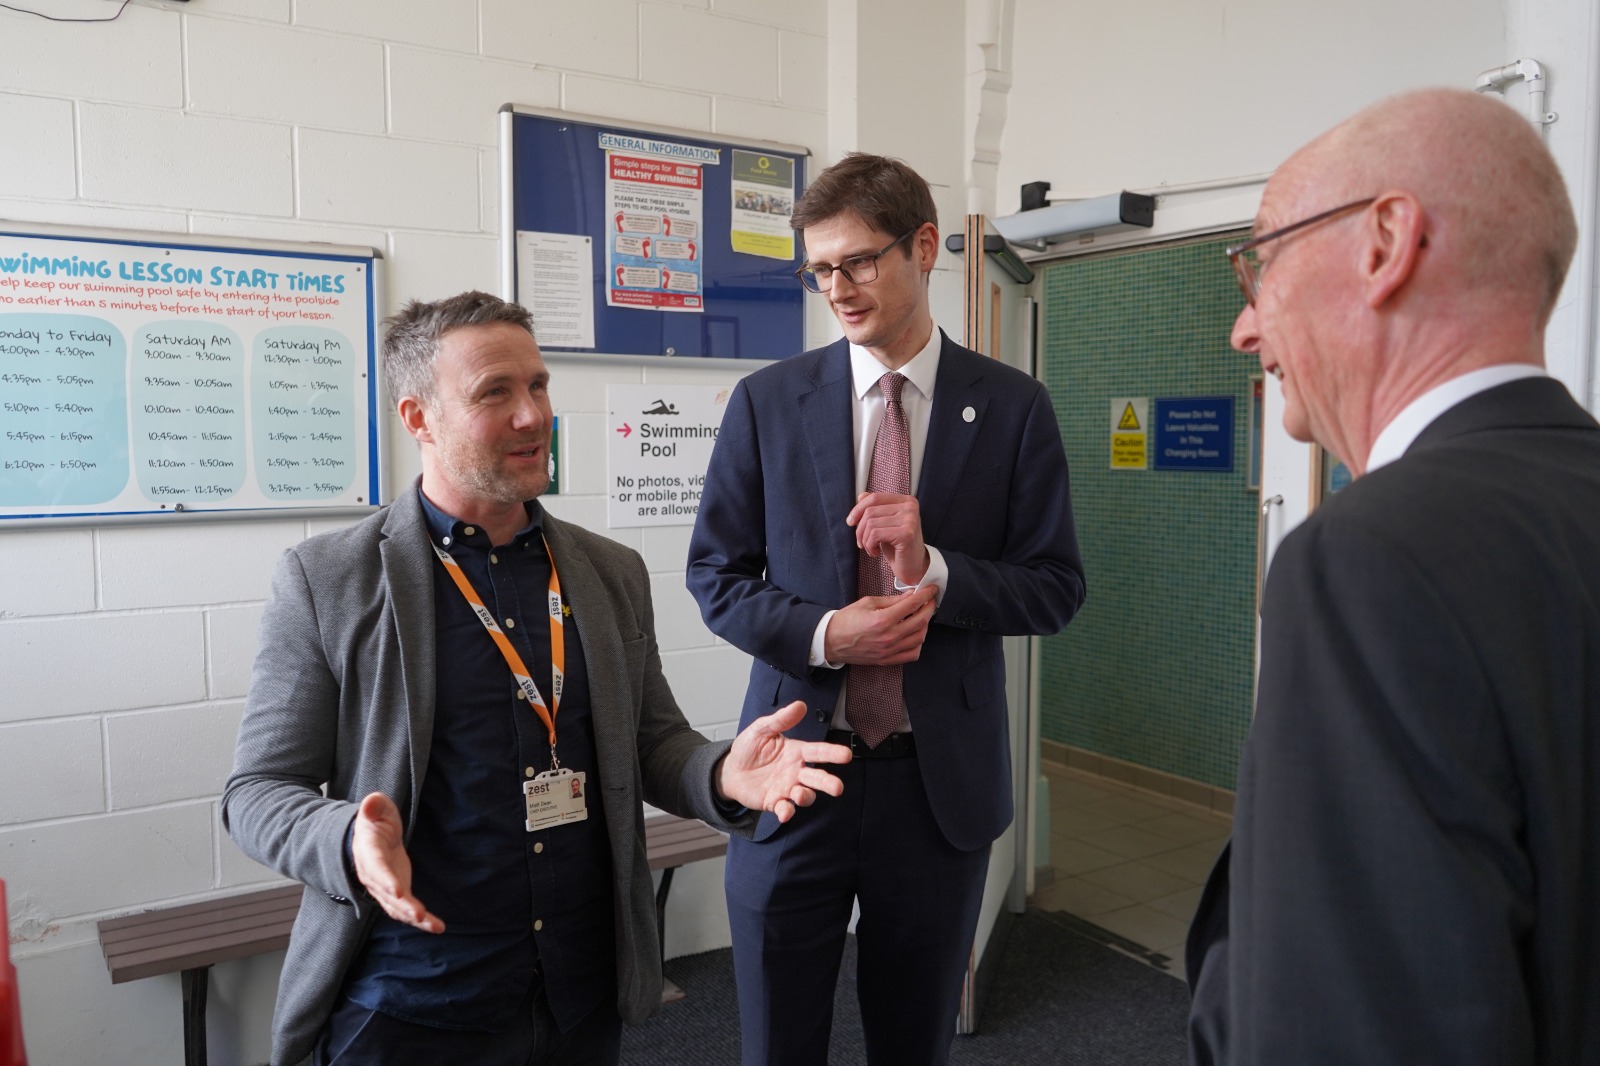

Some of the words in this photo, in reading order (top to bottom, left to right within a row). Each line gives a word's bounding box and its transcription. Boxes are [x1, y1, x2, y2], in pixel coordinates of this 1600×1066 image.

[600, 135, 646, 150] GENERAL
[648, 142, 717, 160] INFORMATION
[613, 158, 639, 169] Simple
[640, 161, 660, 172] steps
[661, 164, 672, 172] for
[613, 168, 652, 181] HEALTHY
[653, 173, 698, 186] SWIMMING
[119, 260, 203, 285] LESSON
[210, 266, 279, 290] START
[24, 279, 55, 292] keep
[59, 282, 81, 291] our
[84, 282, 144, 298] swimming
[147, 287, 173, 298] pool
[176, 287, 201, 299] safe
[204, 289, 219, 301] by
[222, 291, 270, 304] entering
[272, 293, 292, 303] the
[295, 295, 340, 307] poolside
[18, 295, 62, 306] earlier
[64, 297, 95, 307] than
[110, 300, 158, 312] minutes
[160, 302, 200, 315] before
[201, 304, 223, 315] the
[226, 306, 256, 316] start
[258, 307, 272, 320] of
[271, 310, 299, 321] your
[299, 309, 335, 320] lesson.
[46, 329, 64, 341] to
[70, 330, 112, 347] Friday
[146, 333, 206, 350] Saturday
[211, 335, 232, 346] AM
[55, 346, 95, 359] 4:30pm
[264, 338, 320, 355] Saturday
[324, 339, 341, 350] PM
[144, 349, 182, 360] 9:00am
[196, 351, 231, 361] 9:30am
[264, 354, 301, 367] 12:30pm
[313, 356, 342, 367] 1:00pm
[2, 373, 41, 386] 4:35pm
[57, 375, 94, 387] 5:05pm
[144, 377, 181, 387] 9:35am
[194, 379, 232, 388] 10:05am
[269, 380, 298, 391] 1:05pm
[311, 381, 339, 392] 1:35pm
[4, 403, 40, 415] 5:10pm
[55, 403, 94, 415] 5:40pm
[144, 405, 181, 414] 10:10am
[195, 405, 234, 414] 10:40am
[268, 406, 299, 417] 1:40pm
[311, 407, 341, 417] 2:10pm
[1169, 410, 1191, 419] Please
[1192, 410, 1202, 419] Do
[1203, 410, 1217, 419] Not
[1165, 423, 1186, 432] Leave
[1187, 423, 1219, 432] Valuables
[7, 431, 45, 443] 5:45pm
[60, 431, 93, 443] 6:15pm
[148, 432, 188, 441] 10:45am
[201, 432, 232, 441] 11:15am
[268, 432, 298, 443] 2:15pm
[310, 432, 342, 443] 2:45pm
[1114, 438, 1144, 448] Caution
[1188, 436, 1203, 444] This
[640, 443, 676, 457] Pool
[1165, 448, 1197, 459] Changing
[1198, 449, 1219, 458] Room
[5, 460, 45, 471] 6:20pm
[60, 460, 97, 471] 6:50pm
[148, 459, 186, 468] 11:20am
[199, 459, 234, 468] 11:50am
[267, 458, 300, 468] 2:50pm
[312, 457, 345, 468] 3:20pm
[268, 483, 301, 493] 3:25pm
[313, 483, 344, 493] 3:55pm
[617, 476, 634, 487] No
[638, 476, 684, 489] photos,
[194, 485, 233, 496] 12:25pm
[619, 492, 631, 502] or
[636, 489, 678, 501] mobile
[638, 506, 657, 516] are
[661, 503, 698, 516] allowe
[552, 596, 561, 616] zest
[477, 607, 494, 628] zest
[520, 679, 538, 701] zest
[554, 674, 562, 697] zest
[528, 782, 550, 795] zest
